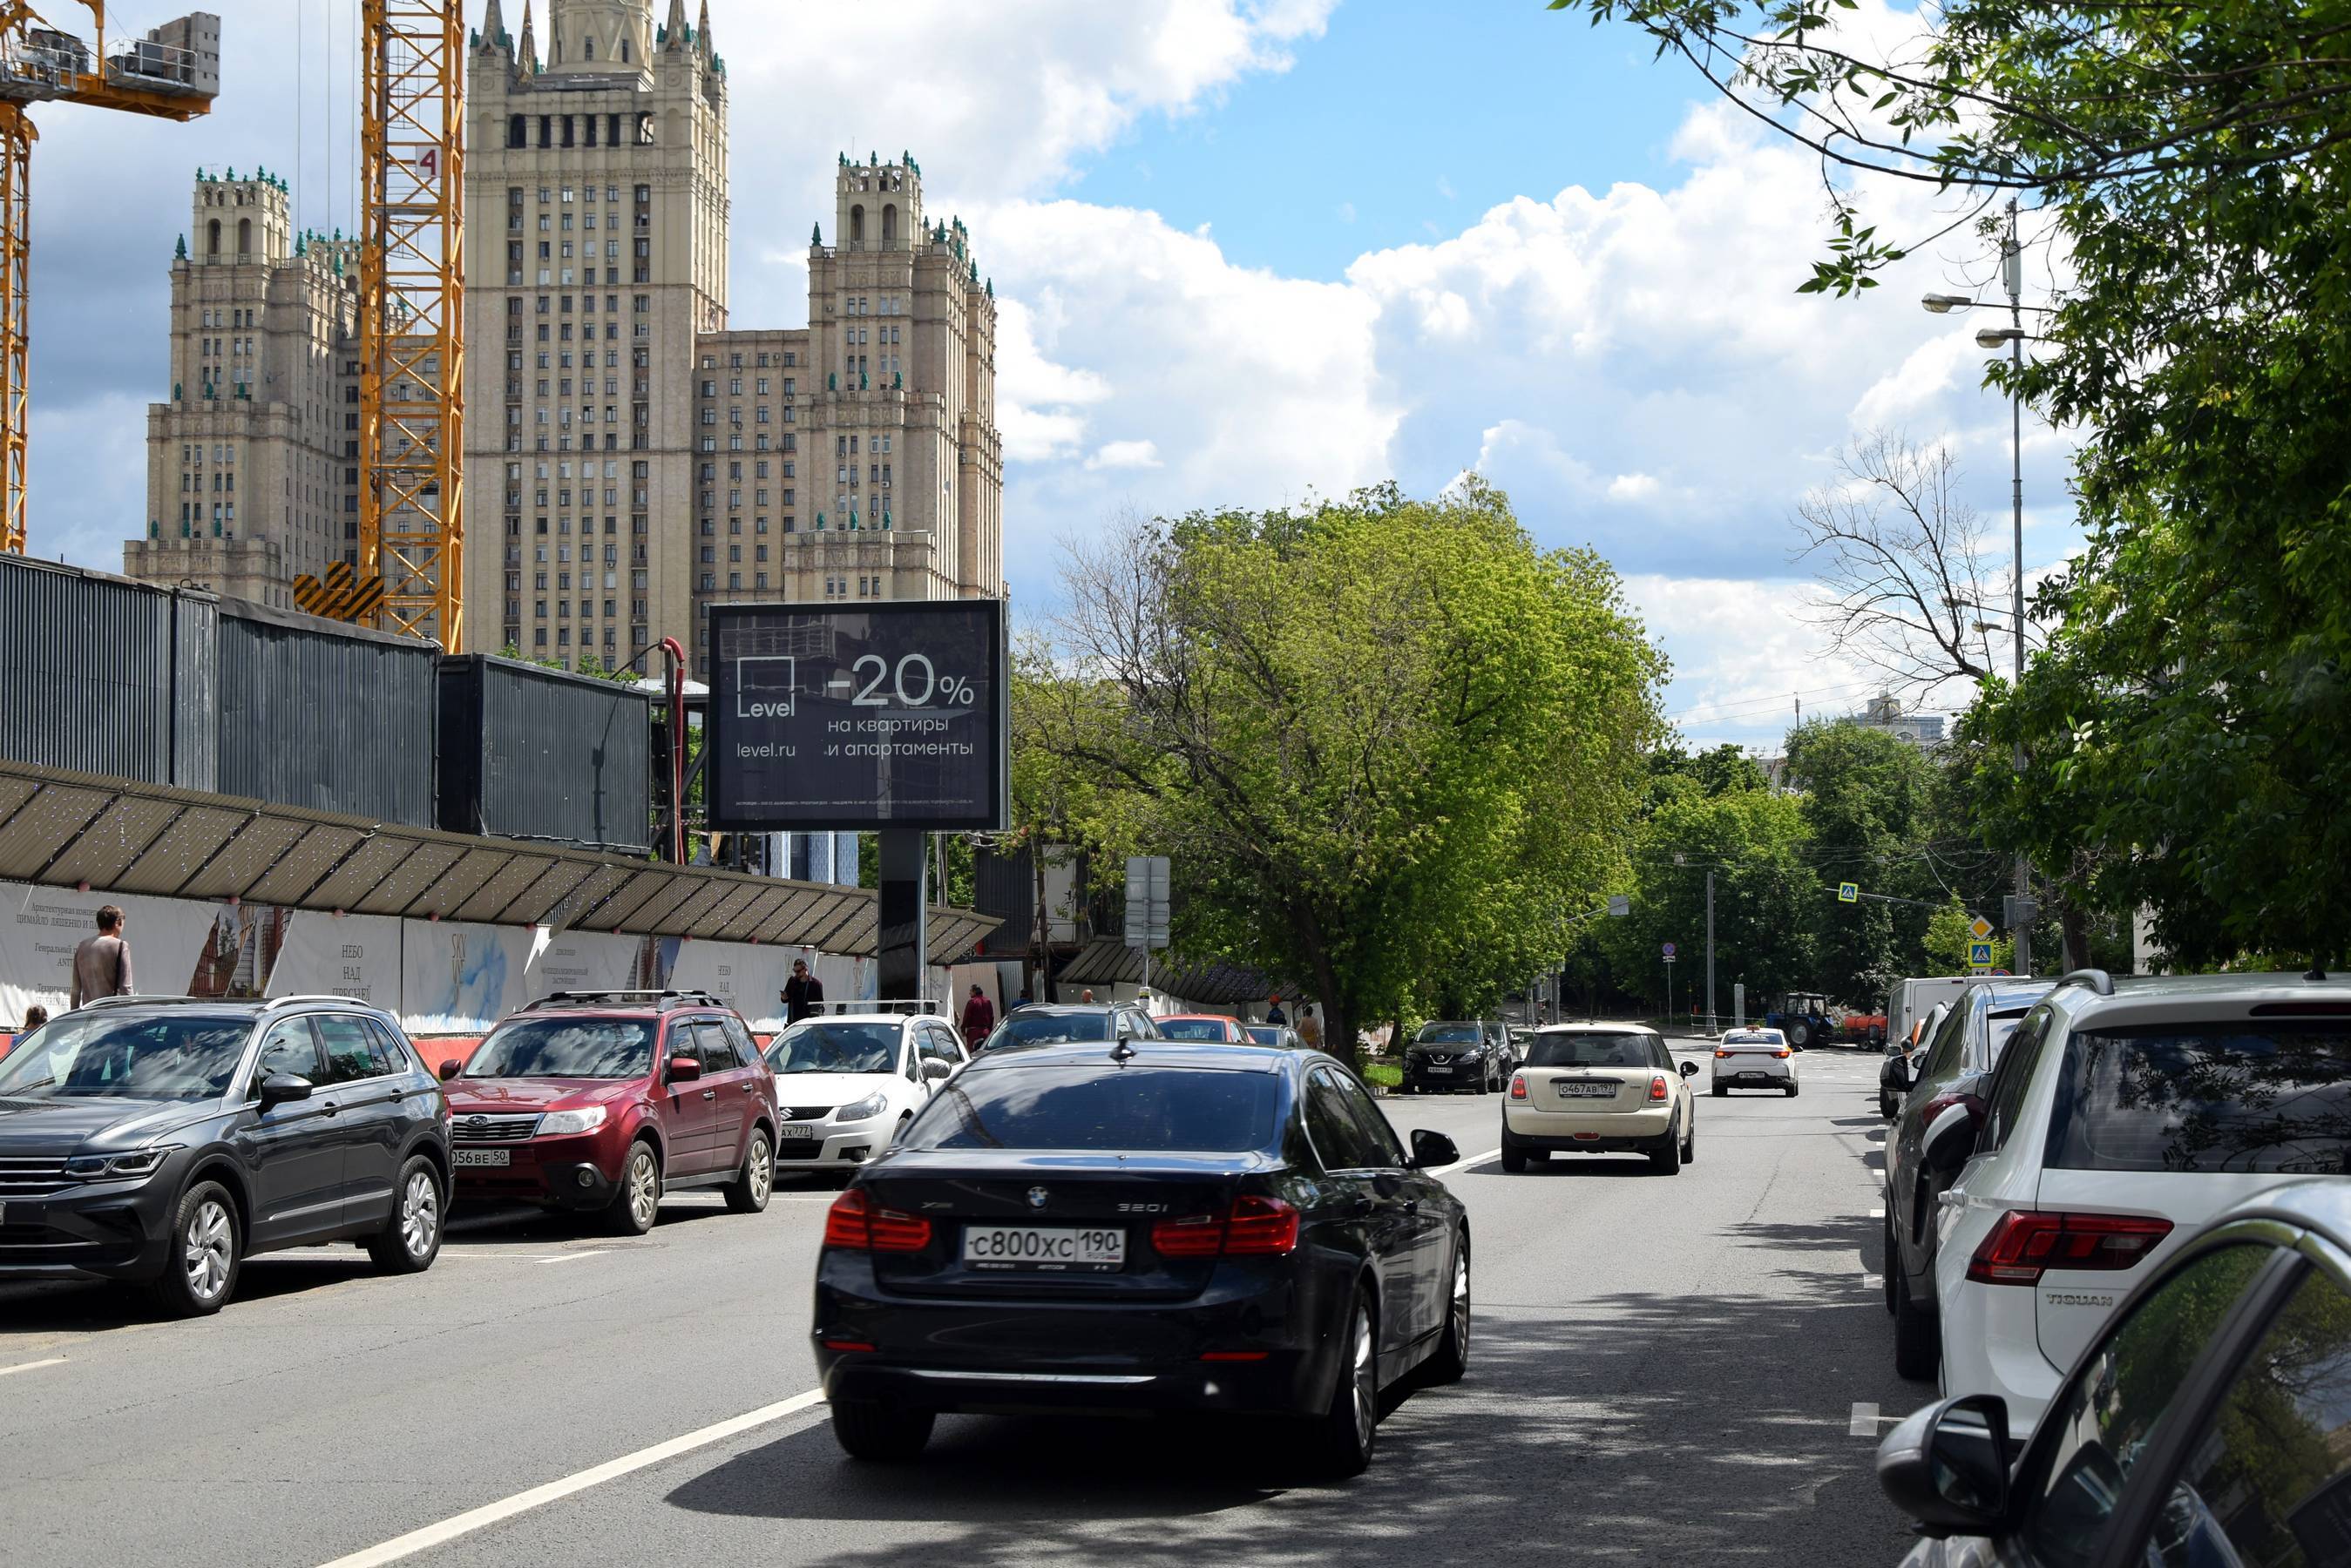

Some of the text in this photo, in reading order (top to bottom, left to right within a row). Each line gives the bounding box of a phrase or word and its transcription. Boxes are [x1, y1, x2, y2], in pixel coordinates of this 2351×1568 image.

[419, 149, 436, 176] 4
[737, 693, 795, 717] Level
[828, 718, 949, 735] на квартиры
[737, 742, 796, 757] level.ru
[828, 742, 973, 760] и апартаменты
[342, 944, 363, 958] НЕБО
[452, 934, 467, 958] SKY
[343, 966, 361, 983] НАД
[1599, 1084, 1612, 1092] 197
[452, 1151, 505, 1164] 056ВЕ 50
[1080, 1231, 1117, 1252] 190
